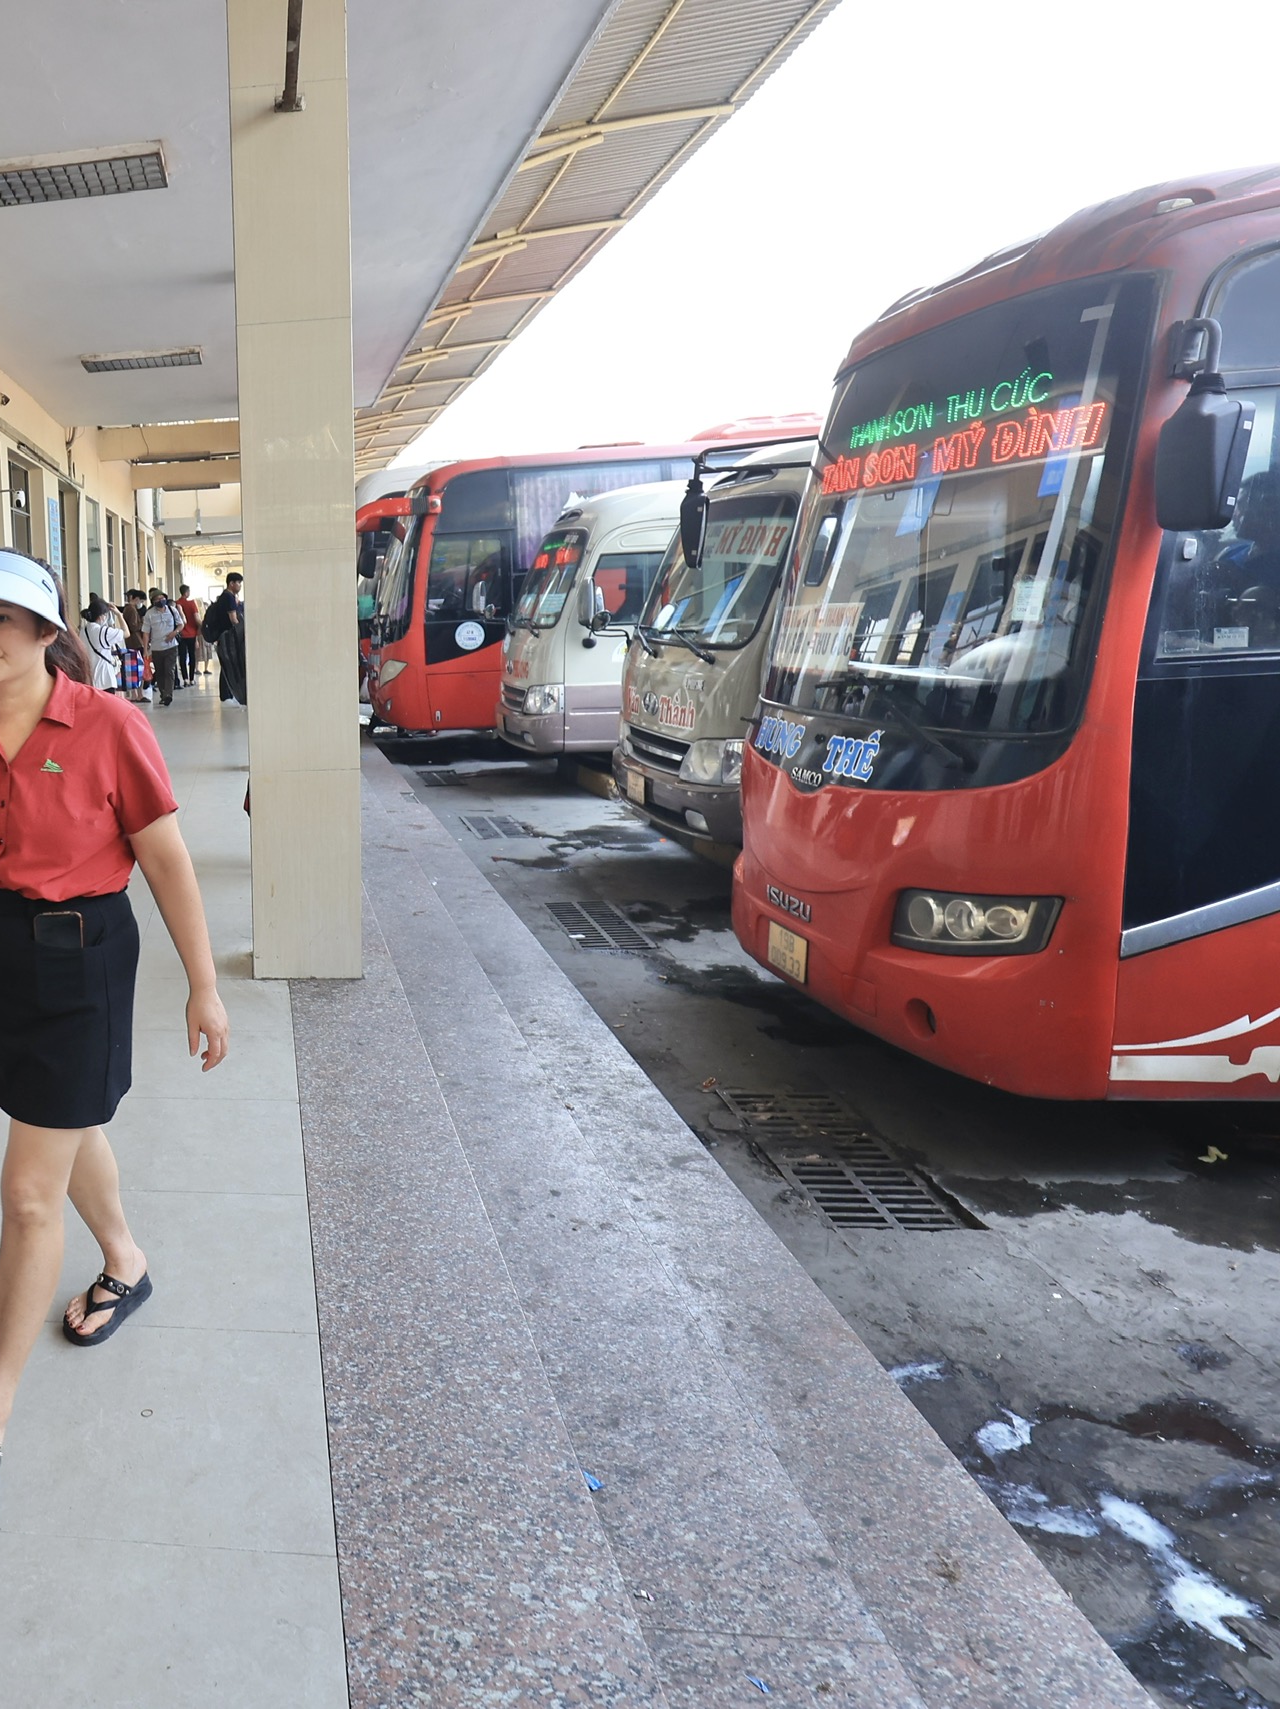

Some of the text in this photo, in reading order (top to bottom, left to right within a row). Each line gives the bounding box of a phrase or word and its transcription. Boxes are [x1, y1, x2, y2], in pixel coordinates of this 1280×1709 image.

[946, 387, 986, 424] THU
[990, 366, 1053, 411] CÚC
[821, 402, 1106, 495] TÂN SƠN MỸ ĐÌNH
[790, 766, 822, 787] SAMCO
[822, 730, 886, 782] THẾ
[766, 884, 812, 922] ISUZU
